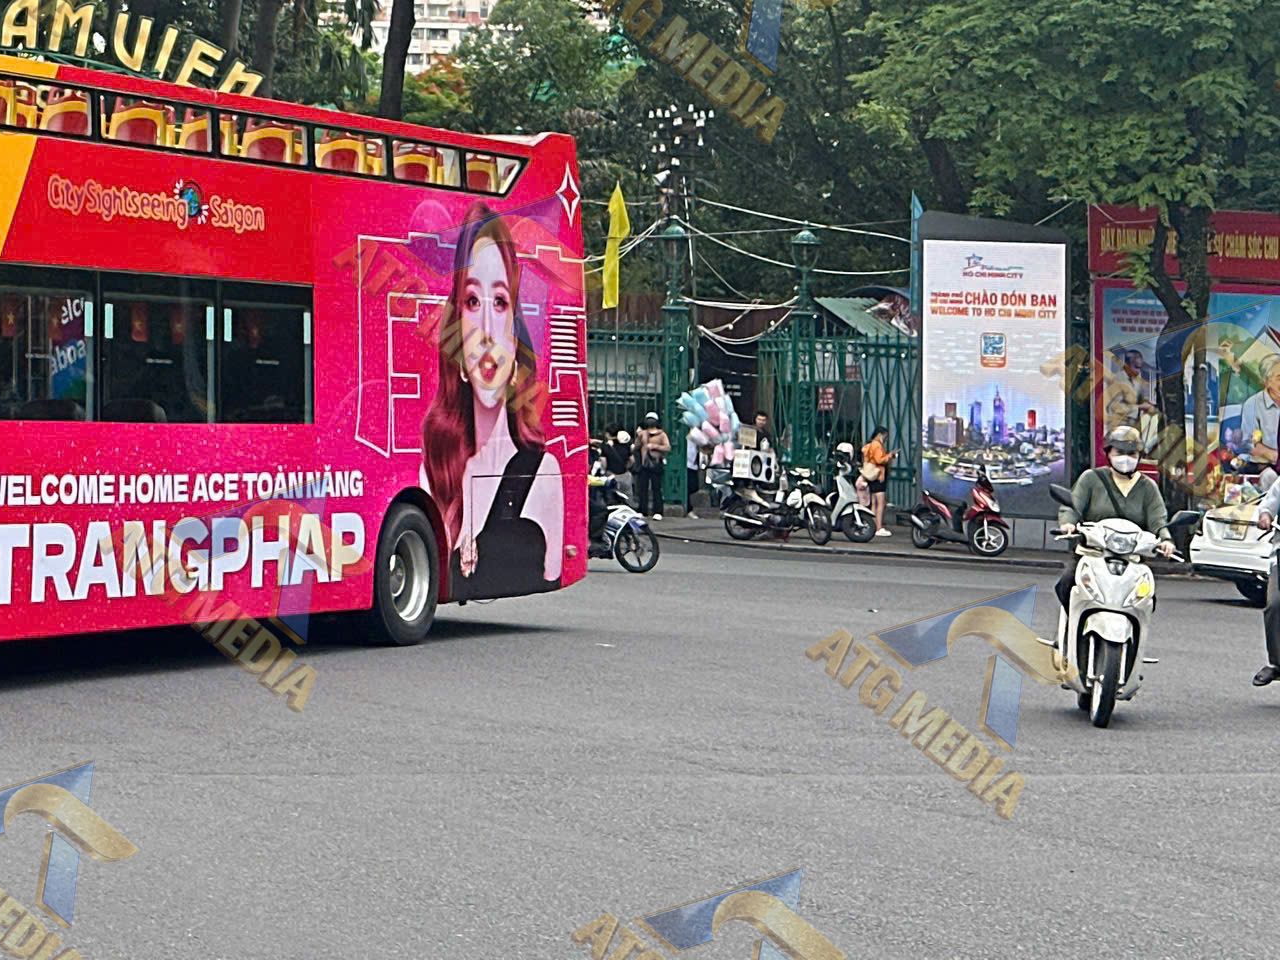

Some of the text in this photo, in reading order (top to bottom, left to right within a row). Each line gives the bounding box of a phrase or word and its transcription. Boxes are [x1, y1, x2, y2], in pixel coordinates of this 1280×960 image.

[209, 195, 264, 233] Saigon
[118, 472, 189, 504] HOME
[192, 472, 239, 502] ACE
[305, 464, 364, 498] NĂNG
